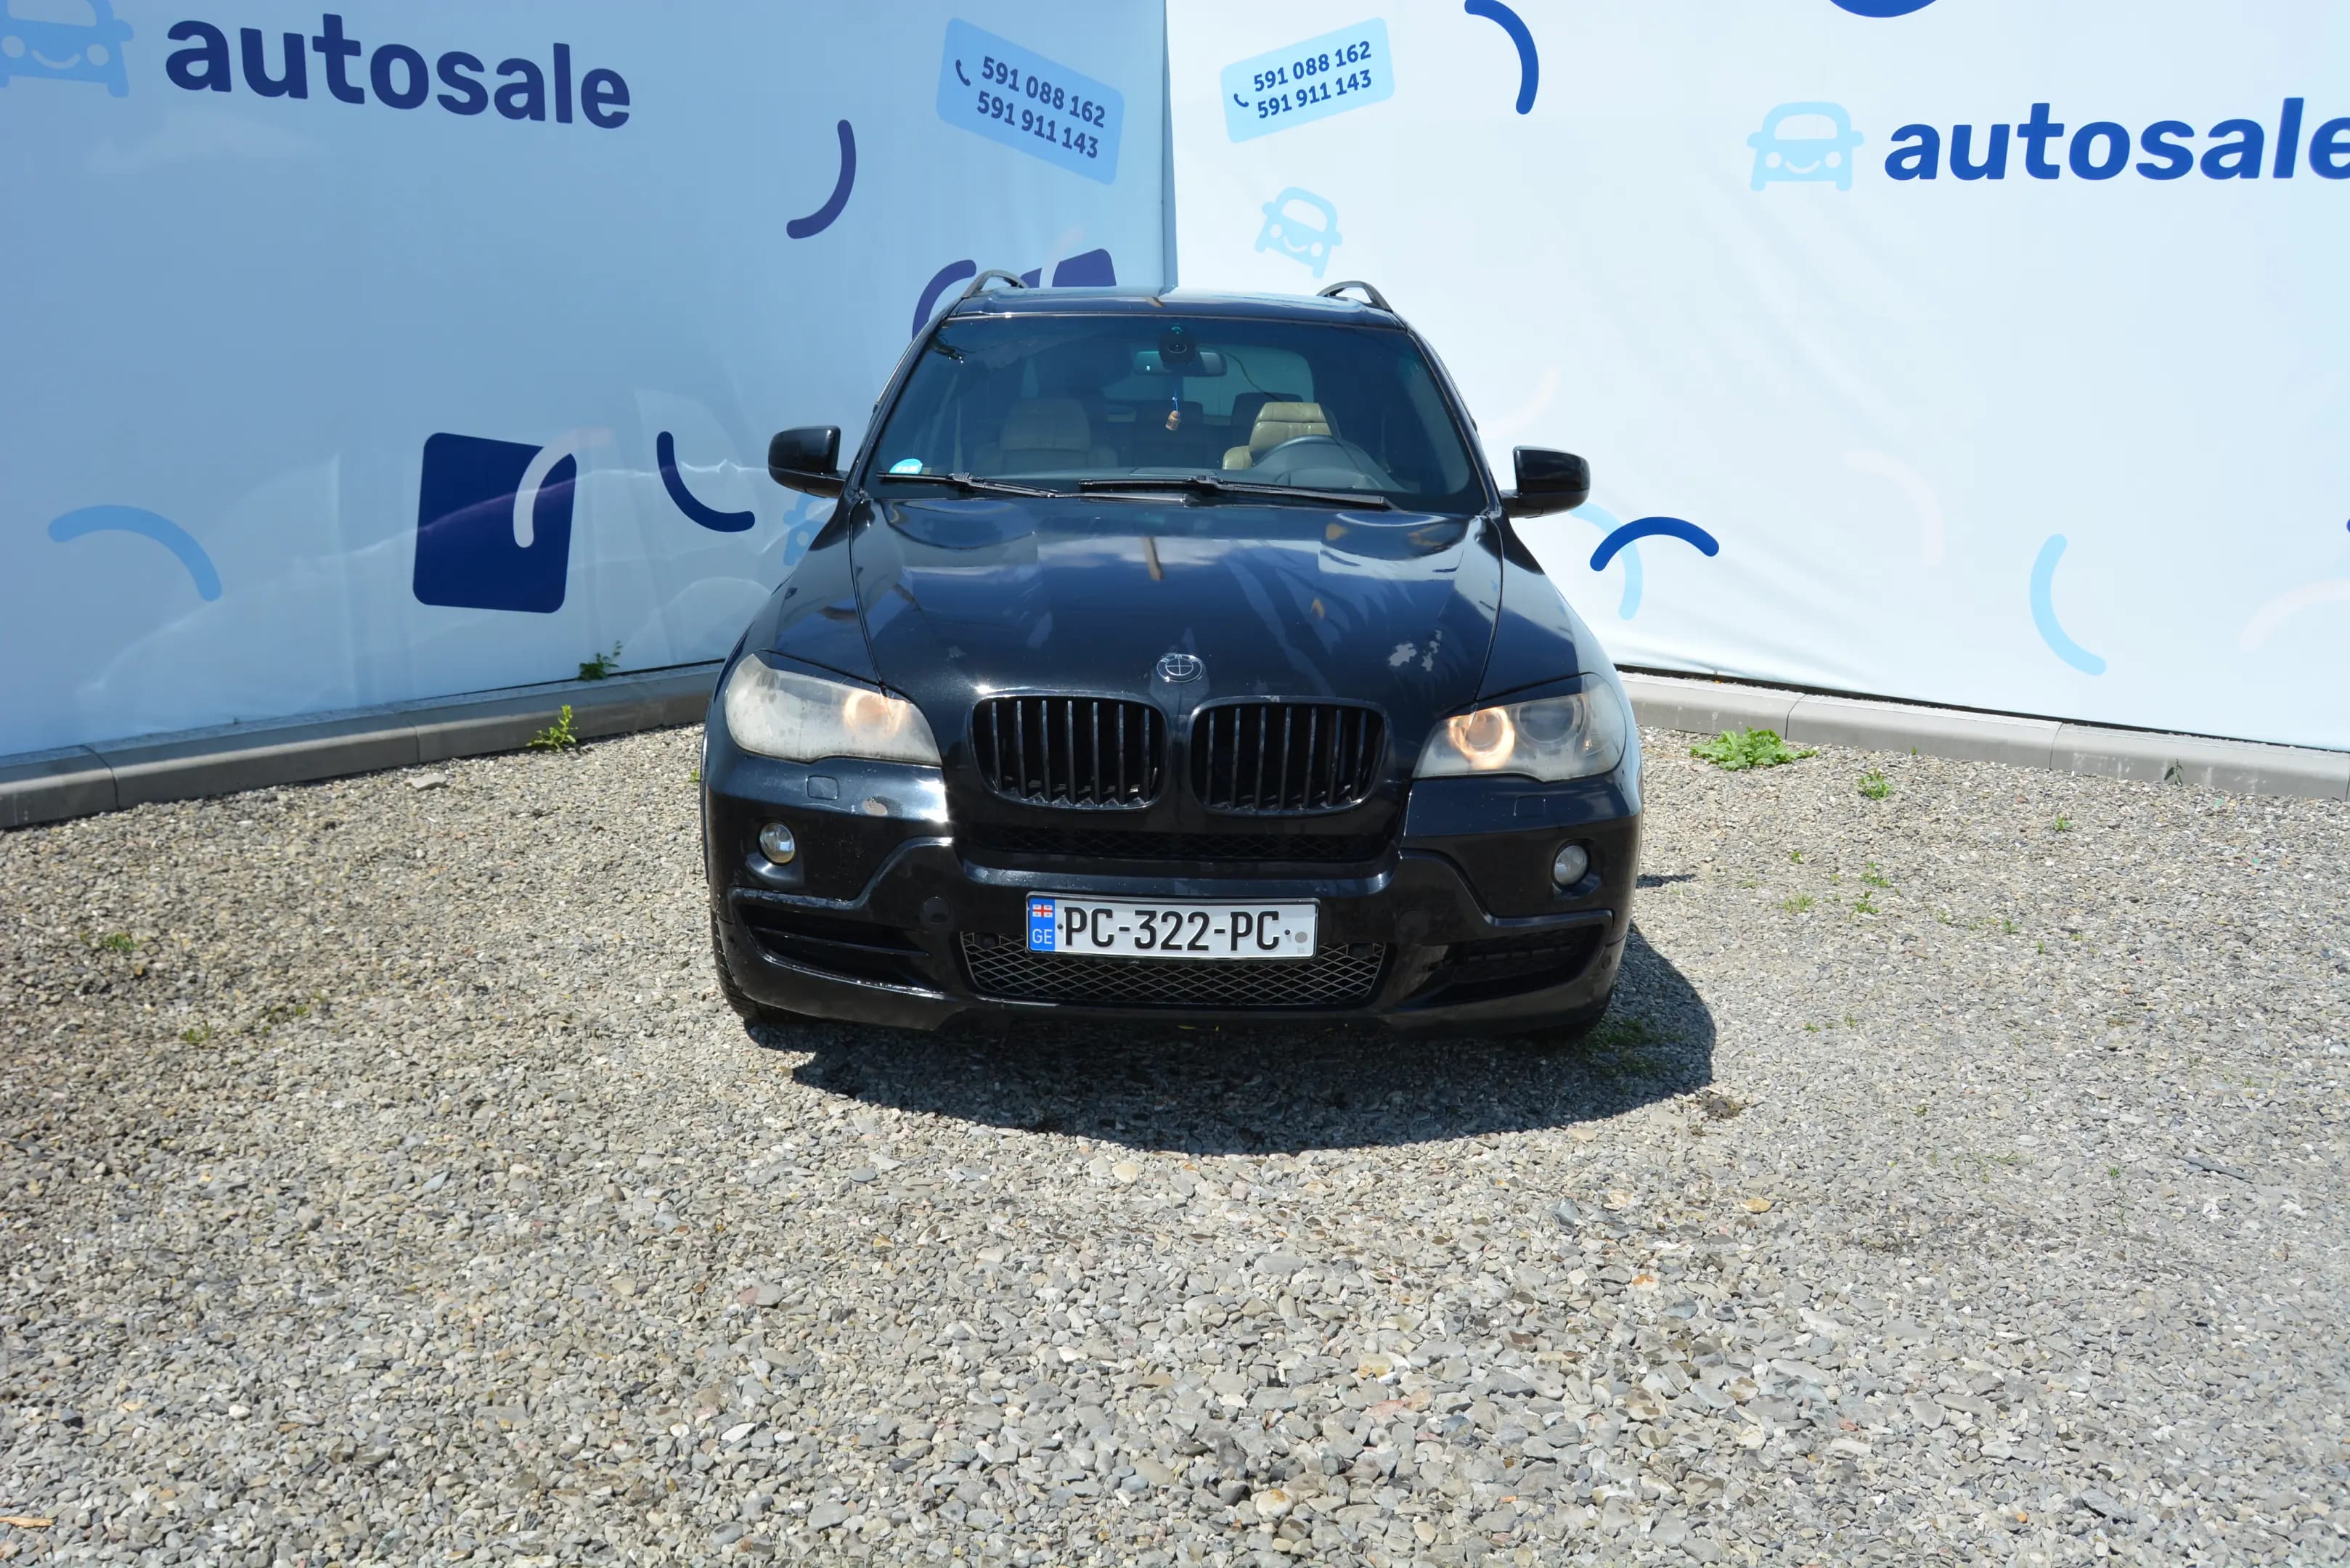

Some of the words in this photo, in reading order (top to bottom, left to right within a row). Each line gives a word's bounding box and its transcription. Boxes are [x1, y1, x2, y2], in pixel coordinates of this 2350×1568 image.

[166, 13, 630, 129] autosale
[981, 55, 1020, 93] 591
[1026, 75, 1065, 110] 088
[1069, 95, 1105, 128] 162
[1254, 67, 1289, 92] 591
[1292, 53, 1330, 80] 088
[1334, 41, 1371, 68] 162
[1257, 94, 1293, 119] 591
[1295, 81, 1331, 108] 911
[1335, 68, 1372, 97] 143
[976, 90, 1016, 126] 591
[1021, 109, 1057, 144] 911
[1061, 126, 1098, 159] 143
[1885, 97, 2350, 181] autosale
[1032, 928, 1053, 944] GE
[1064, 906, 1280, 952] PC-322-PC
